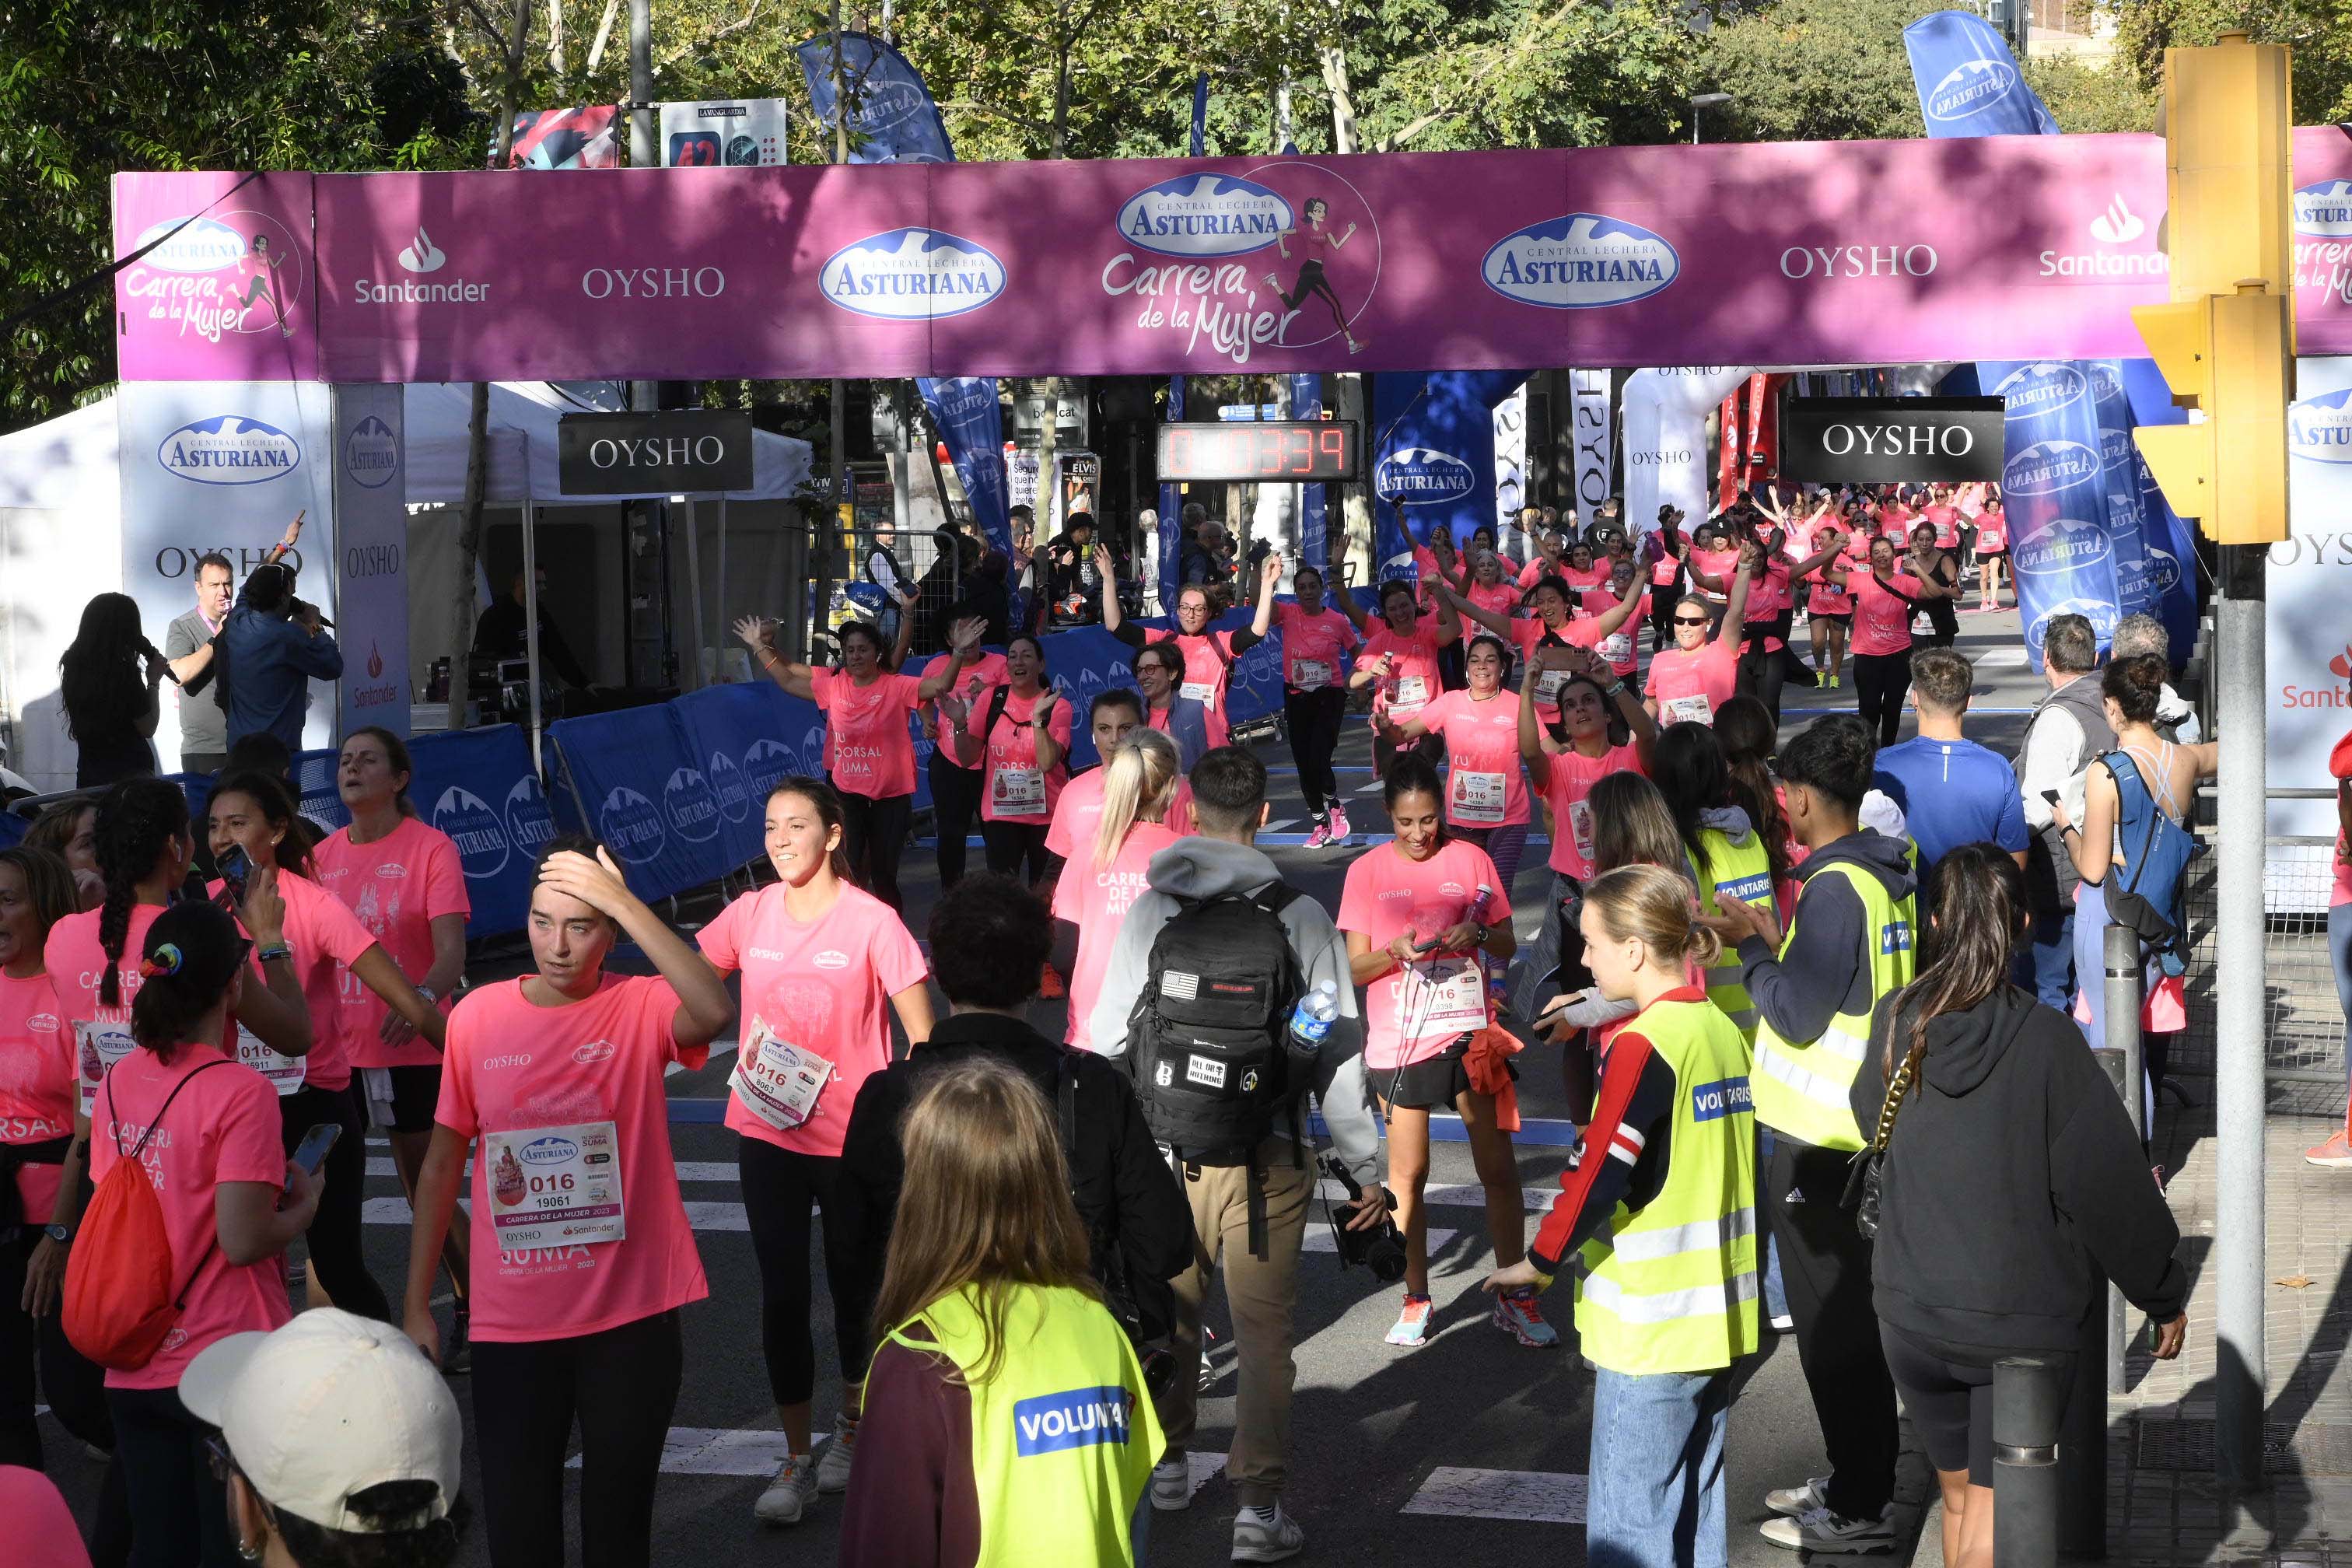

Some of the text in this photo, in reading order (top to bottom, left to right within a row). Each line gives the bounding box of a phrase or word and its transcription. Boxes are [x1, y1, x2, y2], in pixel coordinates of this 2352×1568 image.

[1157, 200, 1275, 211] CENTRAL LECHERA
[1130, 205, 1280, 237] ASTURIANA
[1527, 244, 1657, 257] CENTRAL LECHERA
[863, 257, 985, 268] CENTRAL LECHERA
[1496, 250, 1664, 285] ASTURIANA
[1780, 244, 1938, 278] OYSHO
[125, 268, 219, 297] Carrera
[582, 267, 726, 299] OYSHO
[834, 264, 992, 297] ASTURIANA
[1101, 253, 1247, 297] Carrera
[2312, 266, 2326, 287] la
[355, 278, 490, 303] Santander
[148, 294, 254, 343] de la Mujer
[1137, 290, 1303, 364] de la Mujer
[1822, 424, 1973, 457] OYSHO
[169, 442, 290, 468] ASTURIANA
[350, 446, 394, 471] ASTURIANA
[590, 435, 724, 468] OYSHO
[1633, 450, 1692, 466] OYSHO
[1073, 463, 1096, 473] ELVIS
[1379, 471, 1468, 493] ASTURIANA
[347, 544, 399, 579] OYSHO
[353, 683, 398, 710] Santander
[842, 762, 872, 773] UMA
[1008, 786, 1027, 795] 016
[1468, 791, 1486, 800] 016
[1378, 888, 1412, 901] OYSHO
[1437, 989, 1455, 1000] 16
[100, 1040, 135, 1049] ASTURIANA
[240, 1045, 273, 1059] 016
[484, 1054, 531, 1071] OYSHO
[756, 1062, 787, 1087] 016
[756, 1078, 775, 1094] 8063
[583, 1139, 608, 1147] SUMA
[525, 1149, 574, 1160] ASTURIANA
[530, 1173, 575, 1193] 016
[536, 1195, 570, 1209] 19061
[506, 1213, 539, 1224] CARRERA
[564, 1209, 590, 1218] MUJER
[506, 1223, 615, 1242] OYSHO Santander
[577, 1259, 596, 1269] 2023
